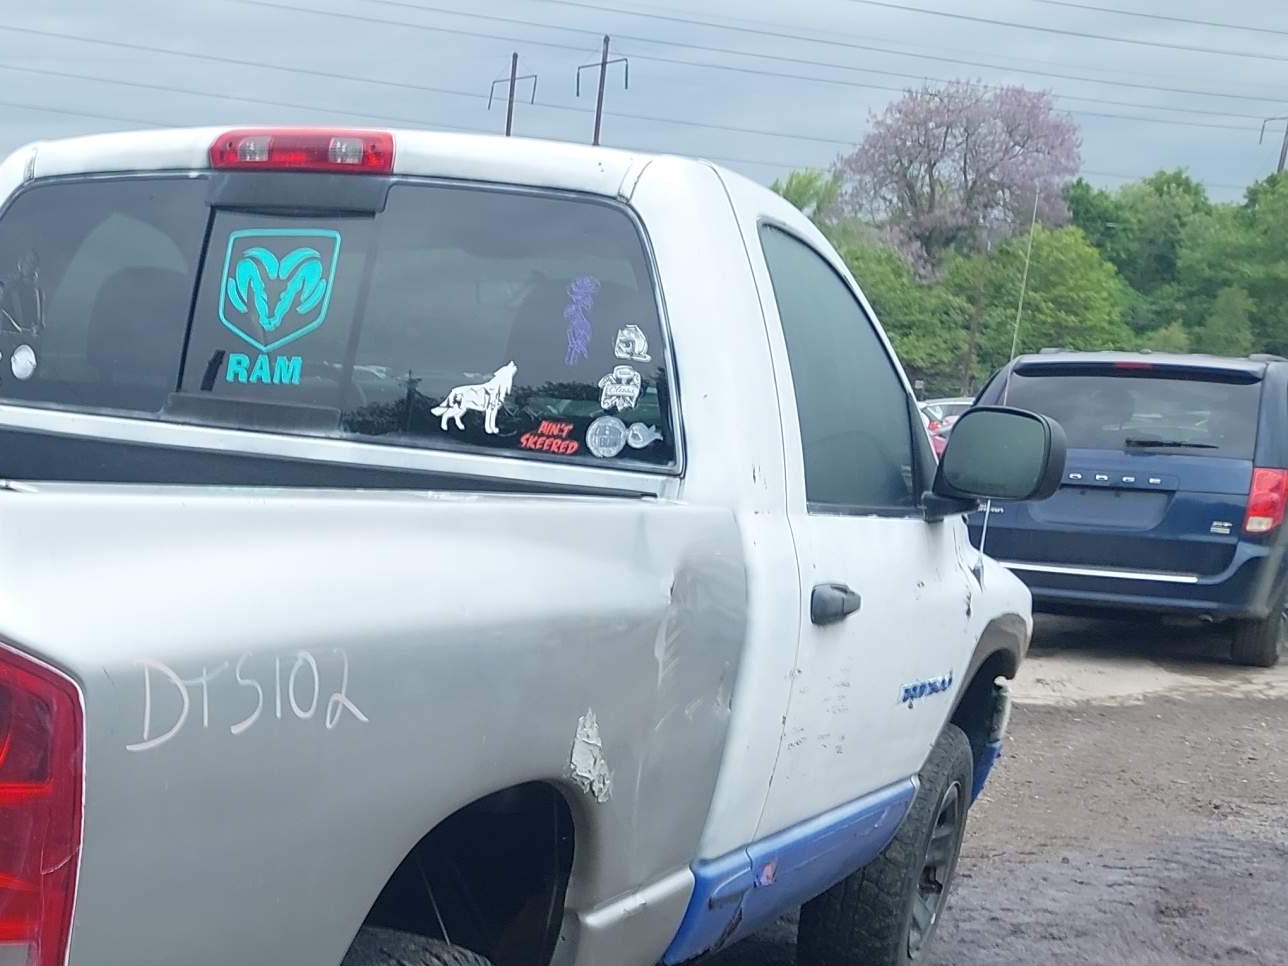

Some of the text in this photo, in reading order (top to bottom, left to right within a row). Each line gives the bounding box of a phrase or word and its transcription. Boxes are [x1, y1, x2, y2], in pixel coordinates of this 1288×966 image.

[226, 352, 303, 385] RAM
[537, 420, 575, 438] AIN'T
[520, 432, 579, 455] SKEERED
